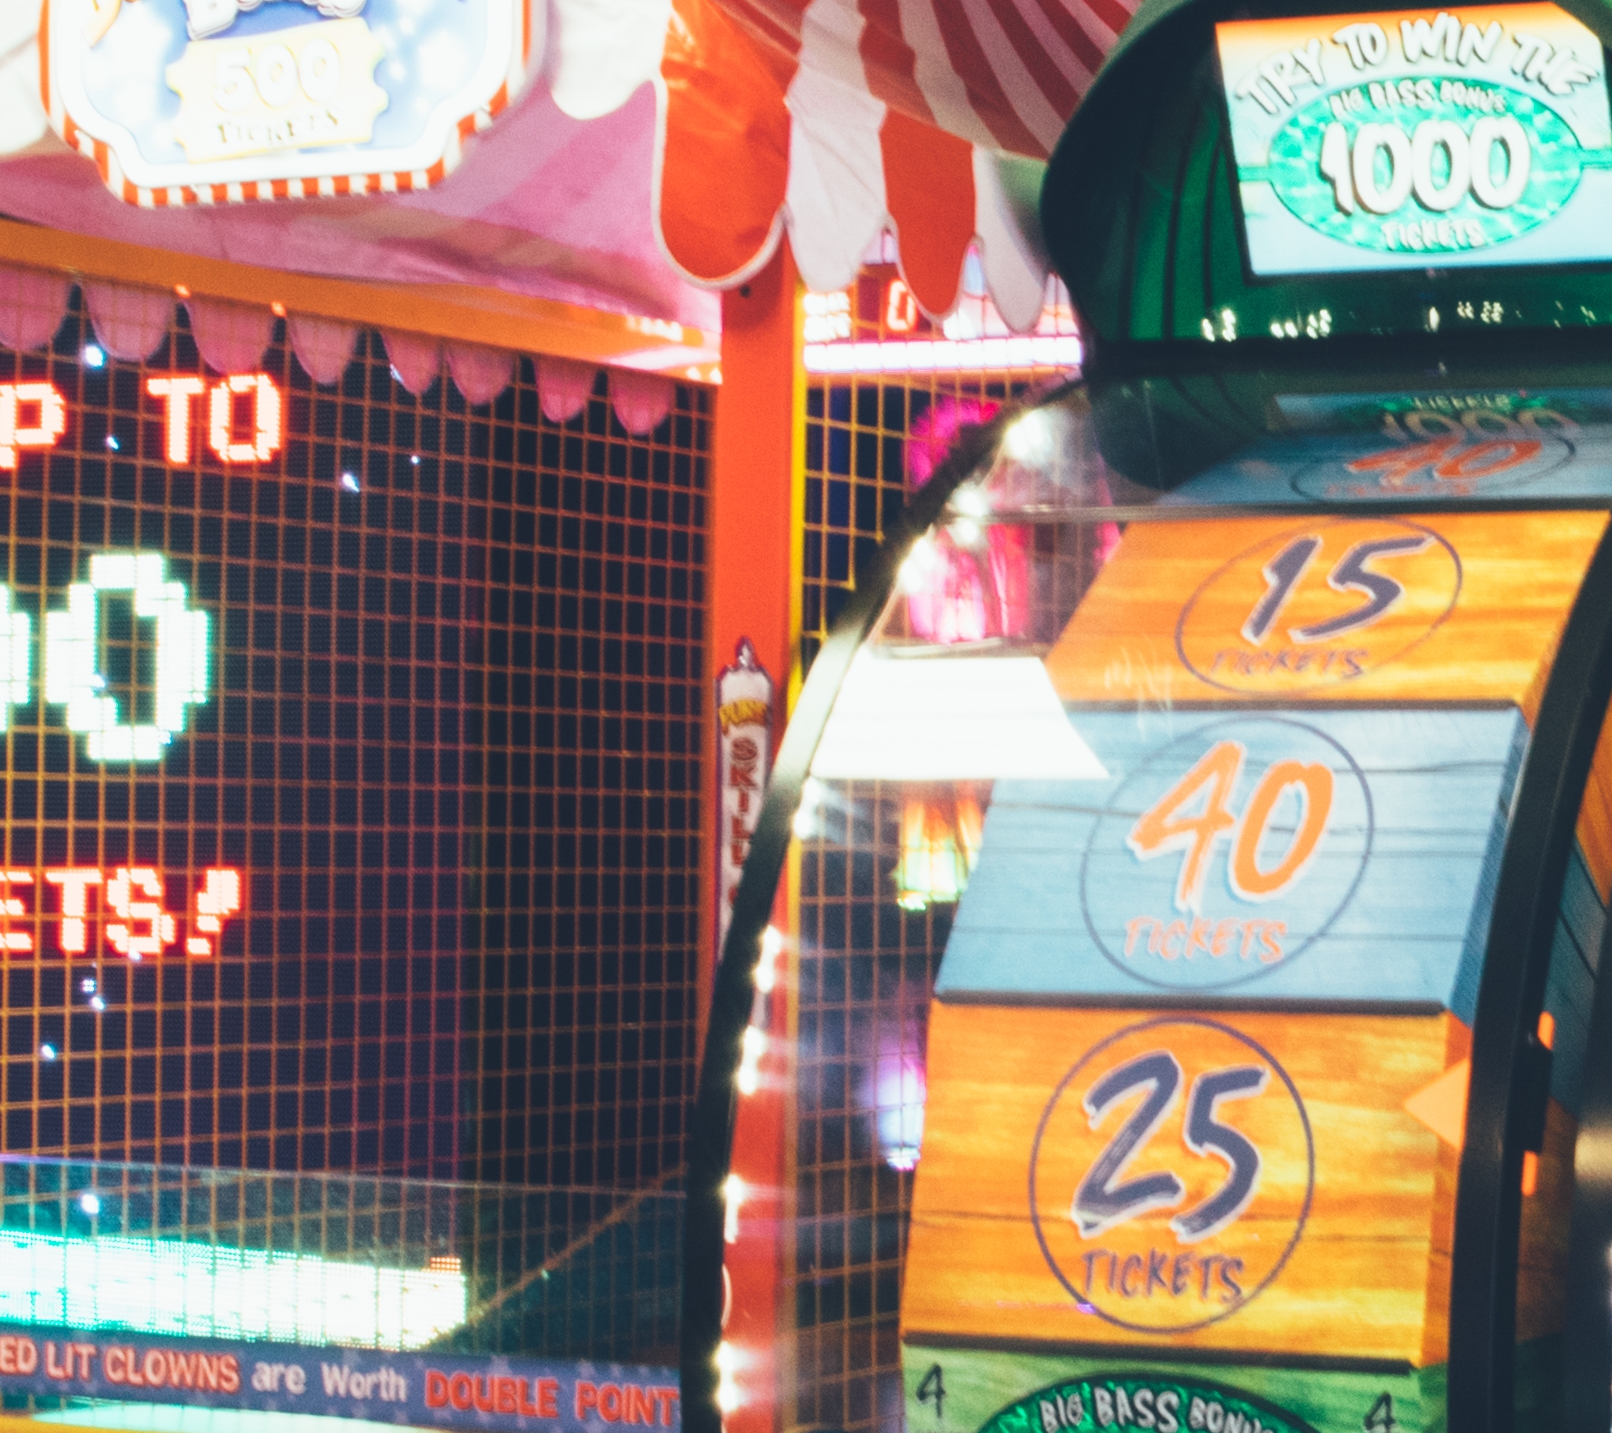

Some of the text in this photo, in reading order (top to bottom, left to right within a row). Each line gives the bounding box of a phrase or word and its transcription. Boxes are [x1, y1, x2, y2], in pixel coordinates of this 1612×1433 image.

[1234, 11, 1600, 120] TRY TO WIN THE
[1318, 115, 1532, 216] 1000
[1381, 217, 1487, 252] TICKETS
[146, 373, 284, 466] TO
[1239, 534, 1437, 646] 15
[1210, 646, 1372, 680] TICKETS
[1124, 737, 1336, 914] 40
[1123, 916, 1288, 965] TICKETS
[1071, 1048, 1268, 1244] 25
[1077, 1249, 1245, 1307] TICKETS
[44, 1337, 99, 1382] LIT
[103, 1341, 242, 1396] CLOWNS
[251, 1361, 307, 1396] are
[320, 1362, 409, 1404] Worth
[424, 1368, 560, 1419] DOUBLE
[916, 1362, 947, 1419] 4
